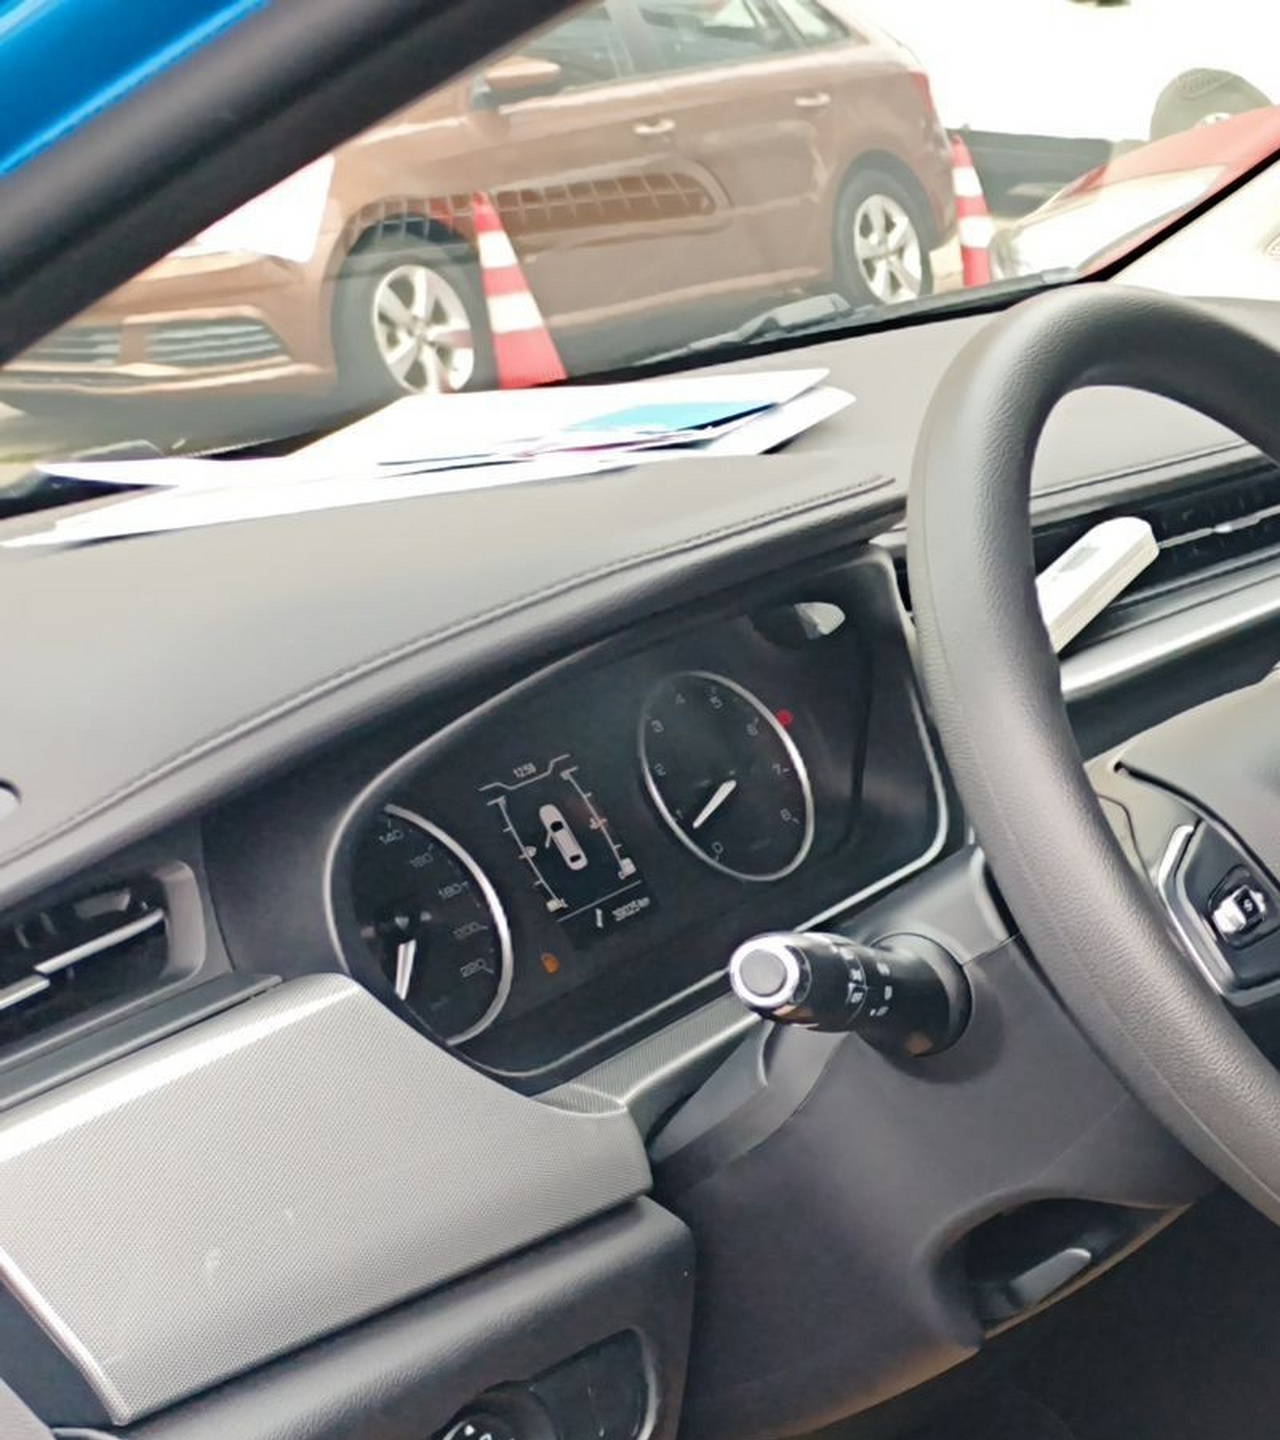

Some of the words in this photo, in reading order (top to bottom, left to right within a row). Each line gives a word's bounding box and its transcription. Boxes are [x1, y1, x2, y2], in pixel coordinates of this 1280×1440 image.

[710, 696, 724, 710] 5
[651, 719, 665, 733] 3
[653, 763, 667, 777] 2
[771, 763, 783, 776] 7
[453, 921, 480, 940] 200
[459, 957, 487, 978] 220
